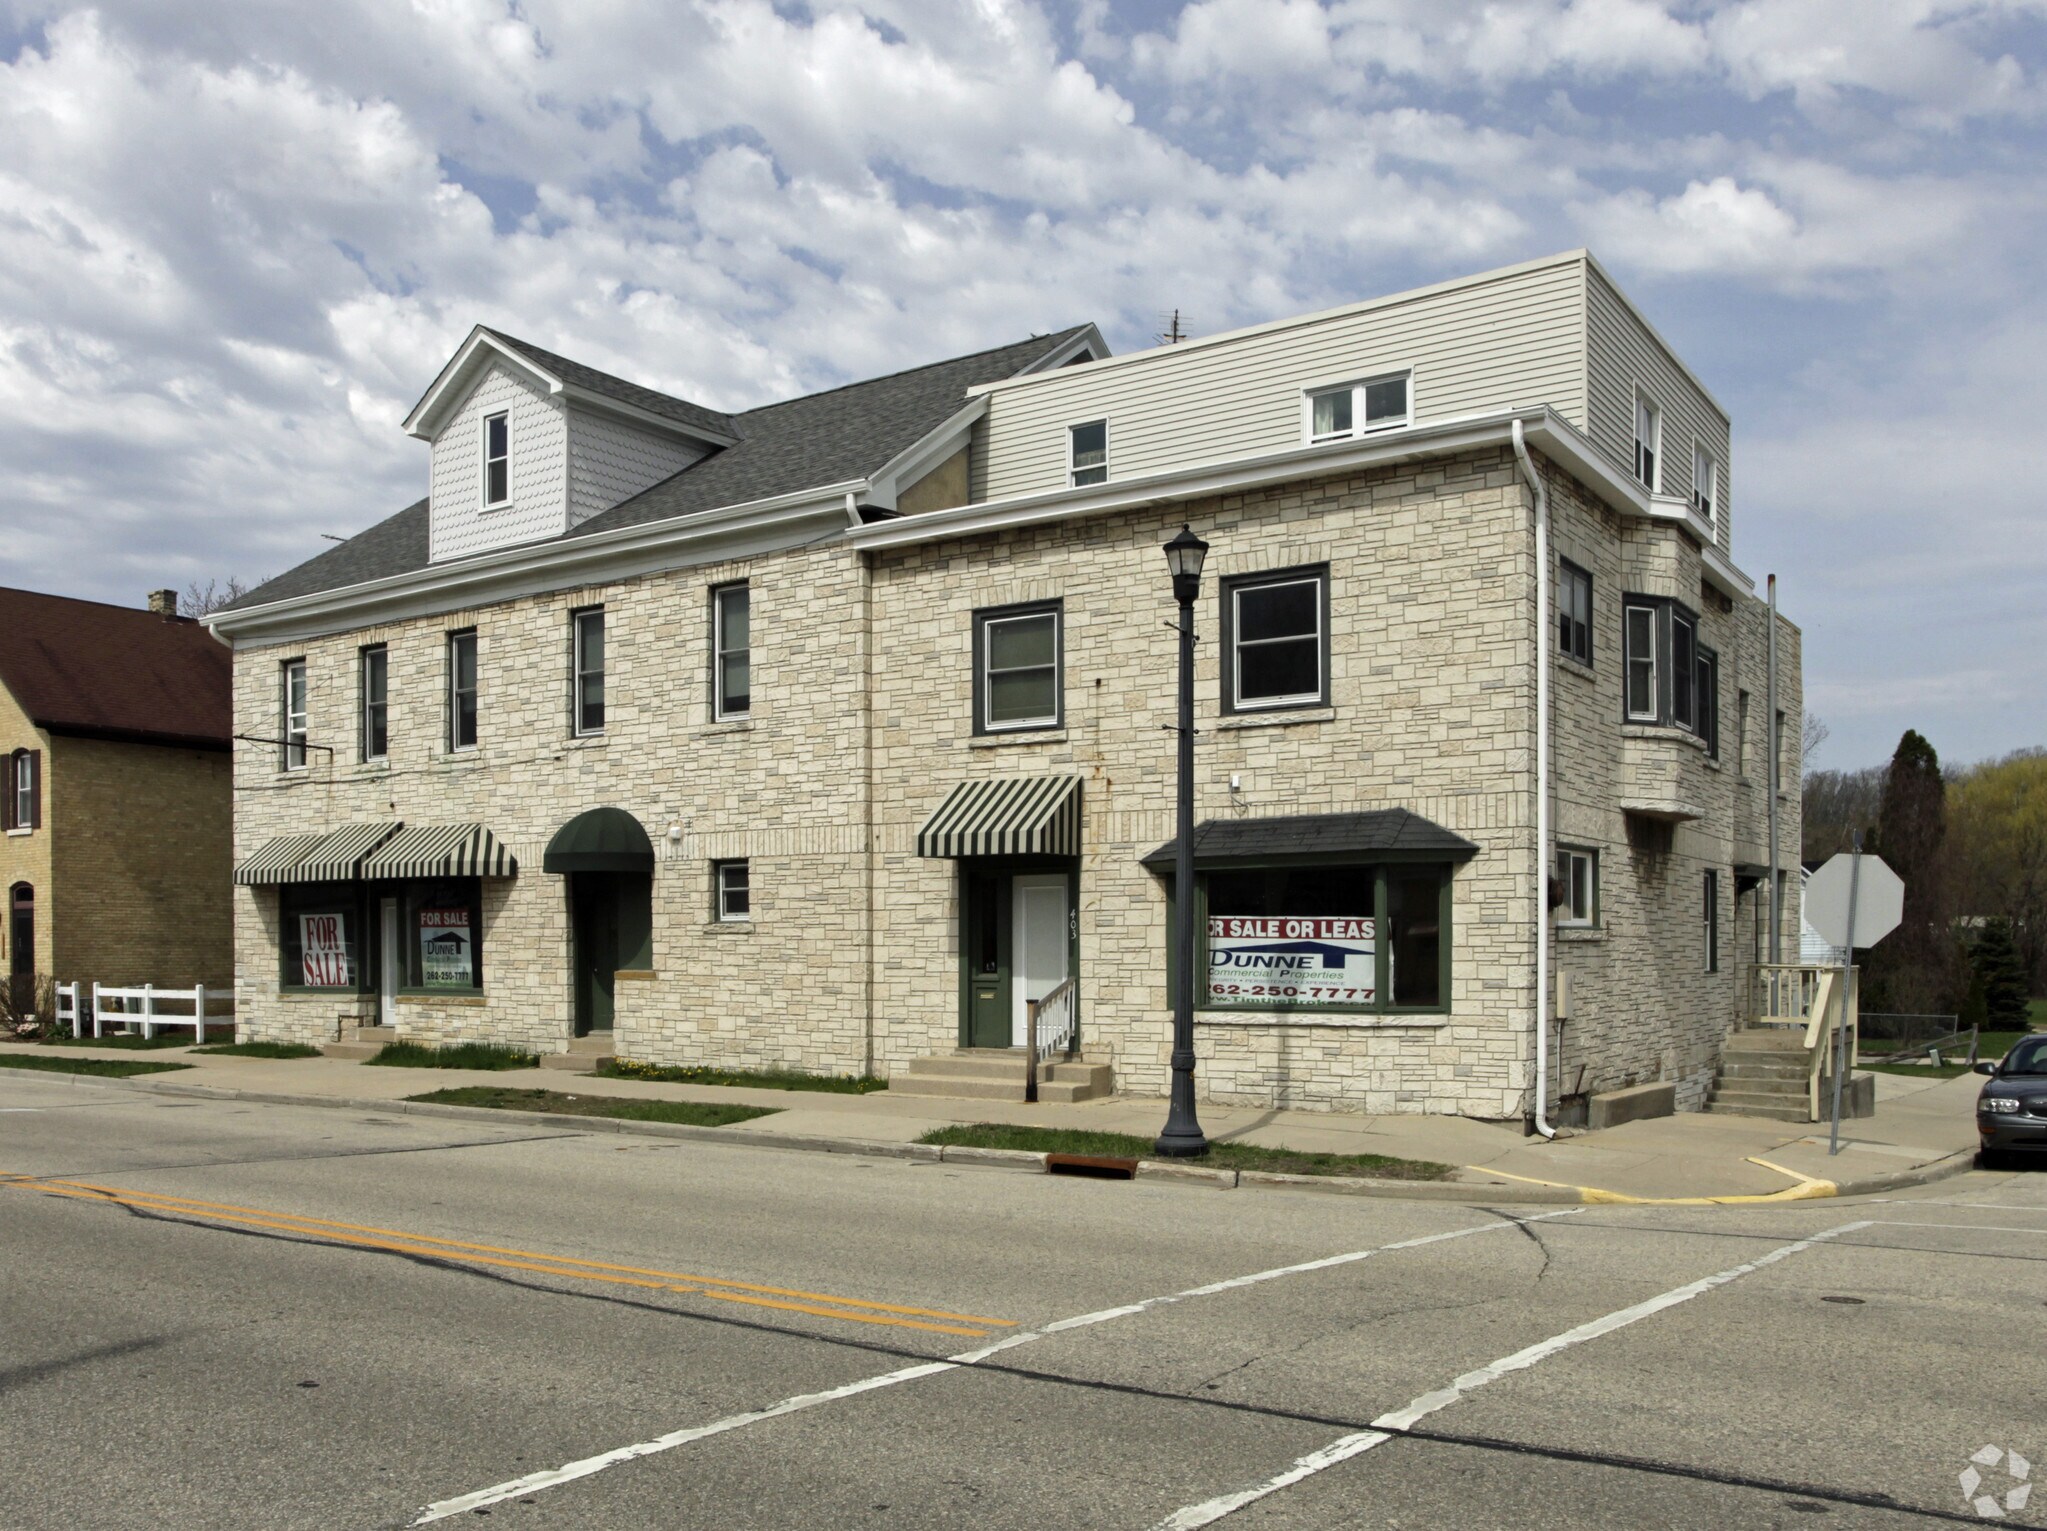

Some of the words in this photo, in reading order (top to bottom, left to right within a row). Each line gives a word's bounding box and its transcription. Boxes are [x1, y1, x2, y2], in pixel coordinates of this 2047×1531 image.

[421, 912, 441, 926] FOR
[443, 912, 469, 926] SALE
[305, 916, 340, 951] FOR
[1208, 920, 1224, 937] OR
[1229, 920, 1280, 938] SALE
[1285, 920, 1314, 939] OR
[1321, 921, 1375, 939] LEAS
[427, 940, 455, 955] DUNNE
[1209, 949, 1314, 969] DUNNE
[304, 952, 348, 986] SALE
[427, 971, 469, 981] 262-250-7777
[1208, 967, 1273, 978] Commercial
[1280, 969, 1344, 981] Properties
